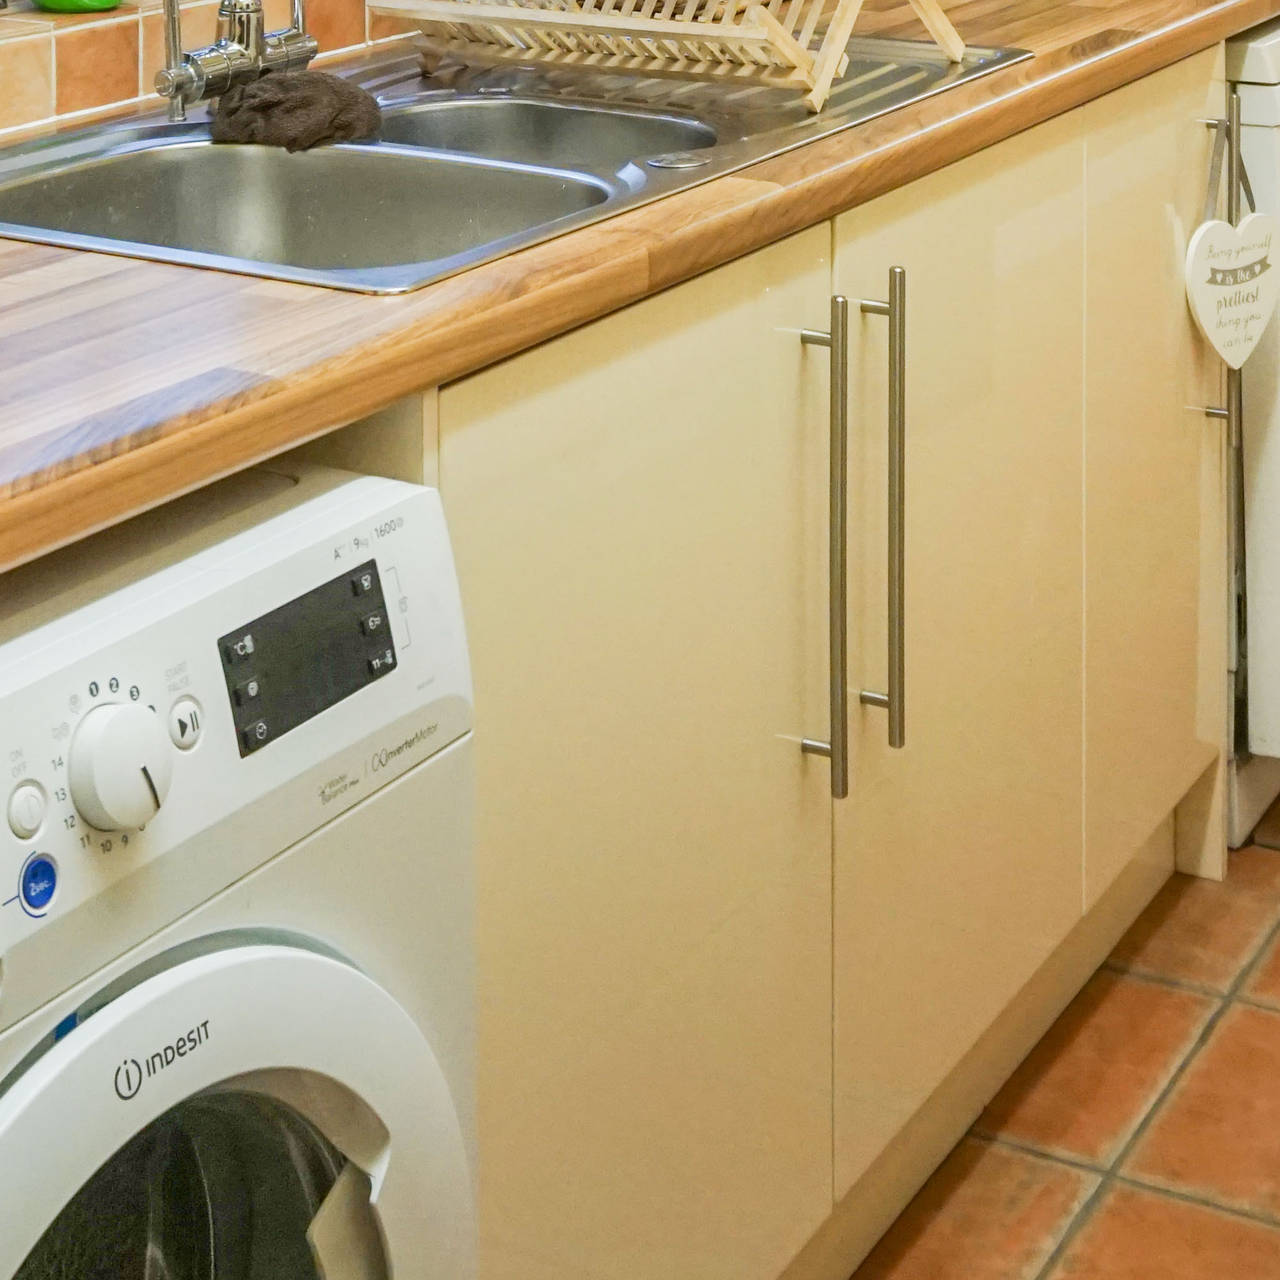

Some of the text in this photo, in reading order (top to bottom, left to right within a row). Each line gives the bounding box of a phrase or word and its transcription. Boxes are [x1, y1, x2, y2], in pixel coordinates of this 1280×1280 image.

[1237, 268, 1251, 283] the
[1216, 286, 1259, 315] prettiest
[374, 519, 398, 539] 1600
[52, 756, 64, 770] 14
[55, 788, 67, 802] 13
[64, 815, 76, 830] 12
[80, 835, 90, 849] 11
[101, 840, 113, 854] 10
